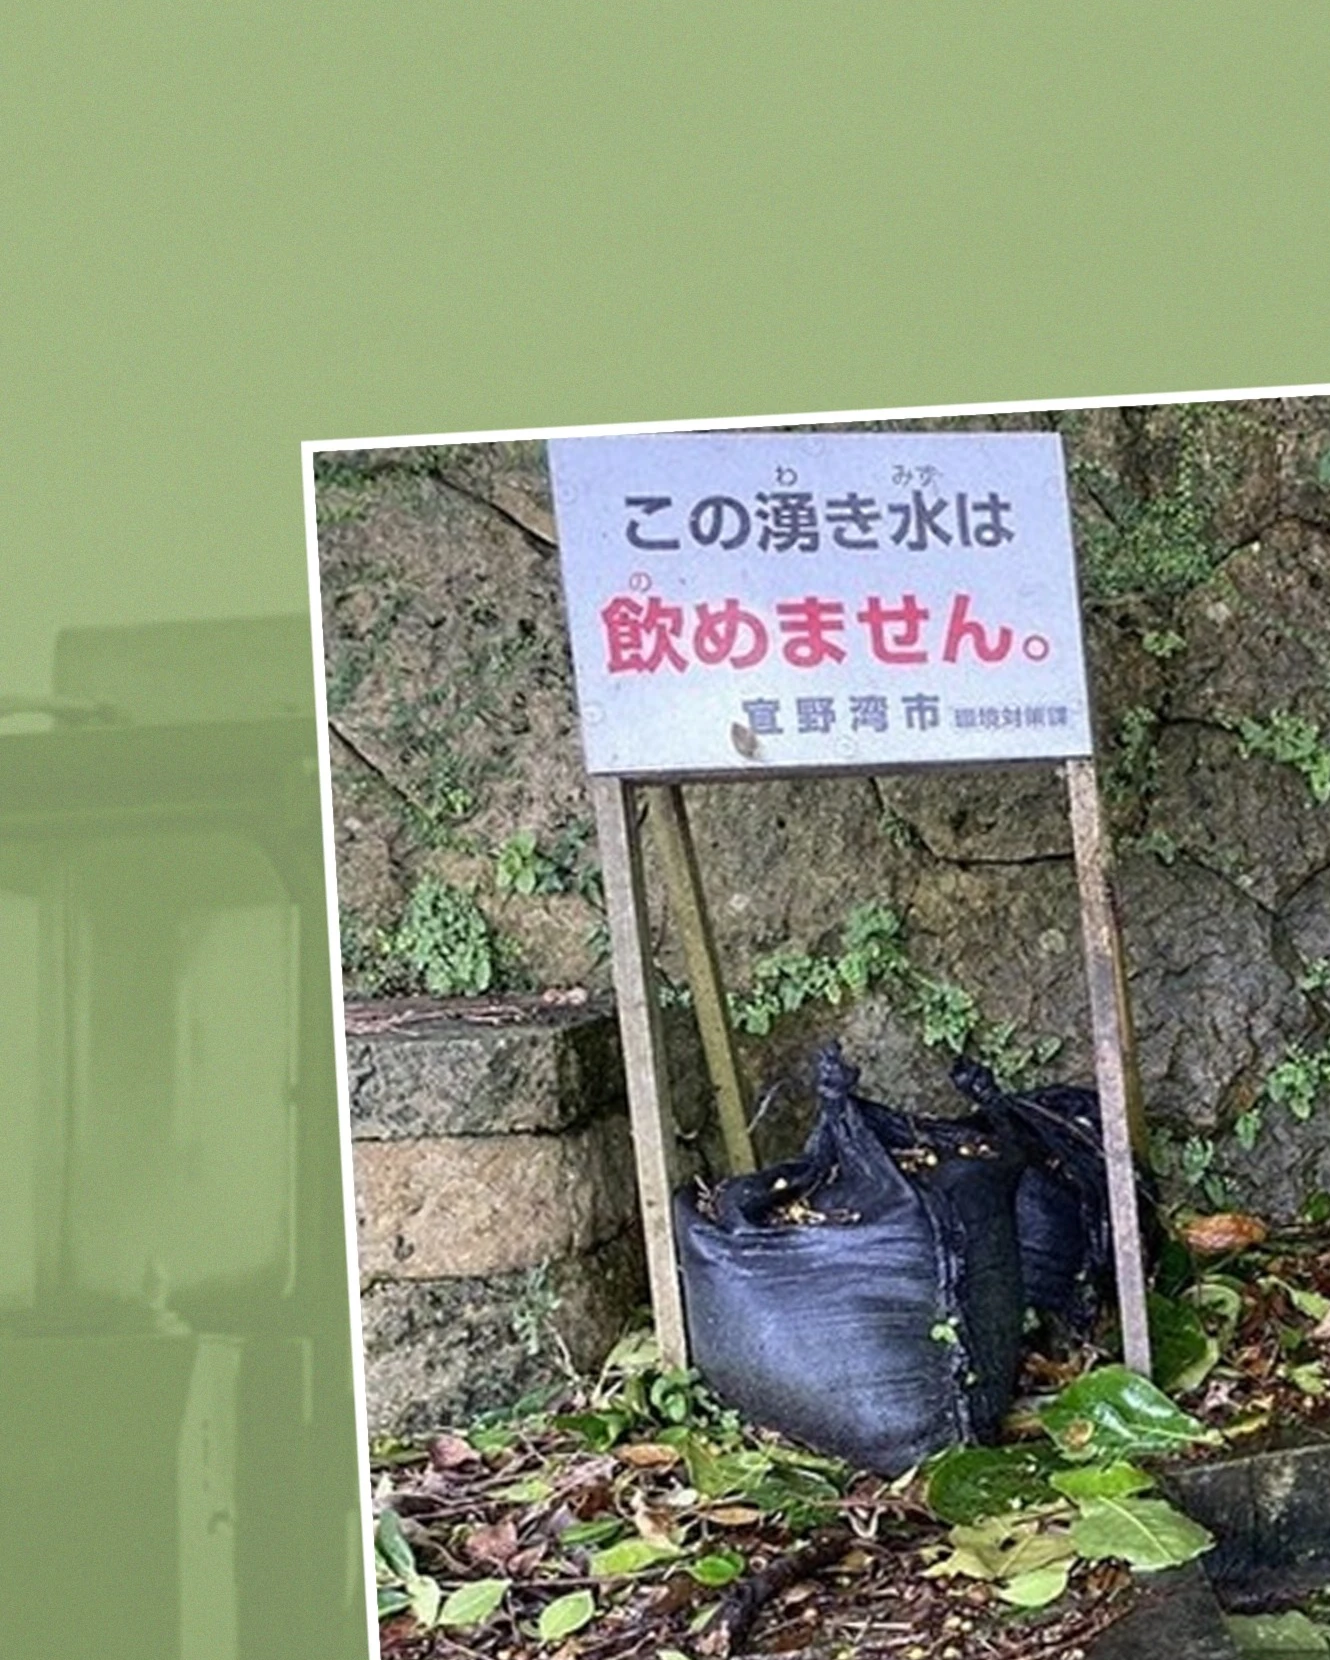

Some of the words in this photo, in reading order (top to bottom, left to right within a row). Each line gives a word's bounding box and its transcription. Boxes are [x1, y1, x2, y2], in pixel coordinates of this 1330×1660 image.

[775, 466, 798, 487] わ
[624, 490, 1015, 553] この湧き水は
[629, 571, 653, 593] の
[602, 593, 1050, 676] 飲めません。
[741, 693, 940, 735] 宜野湾市
